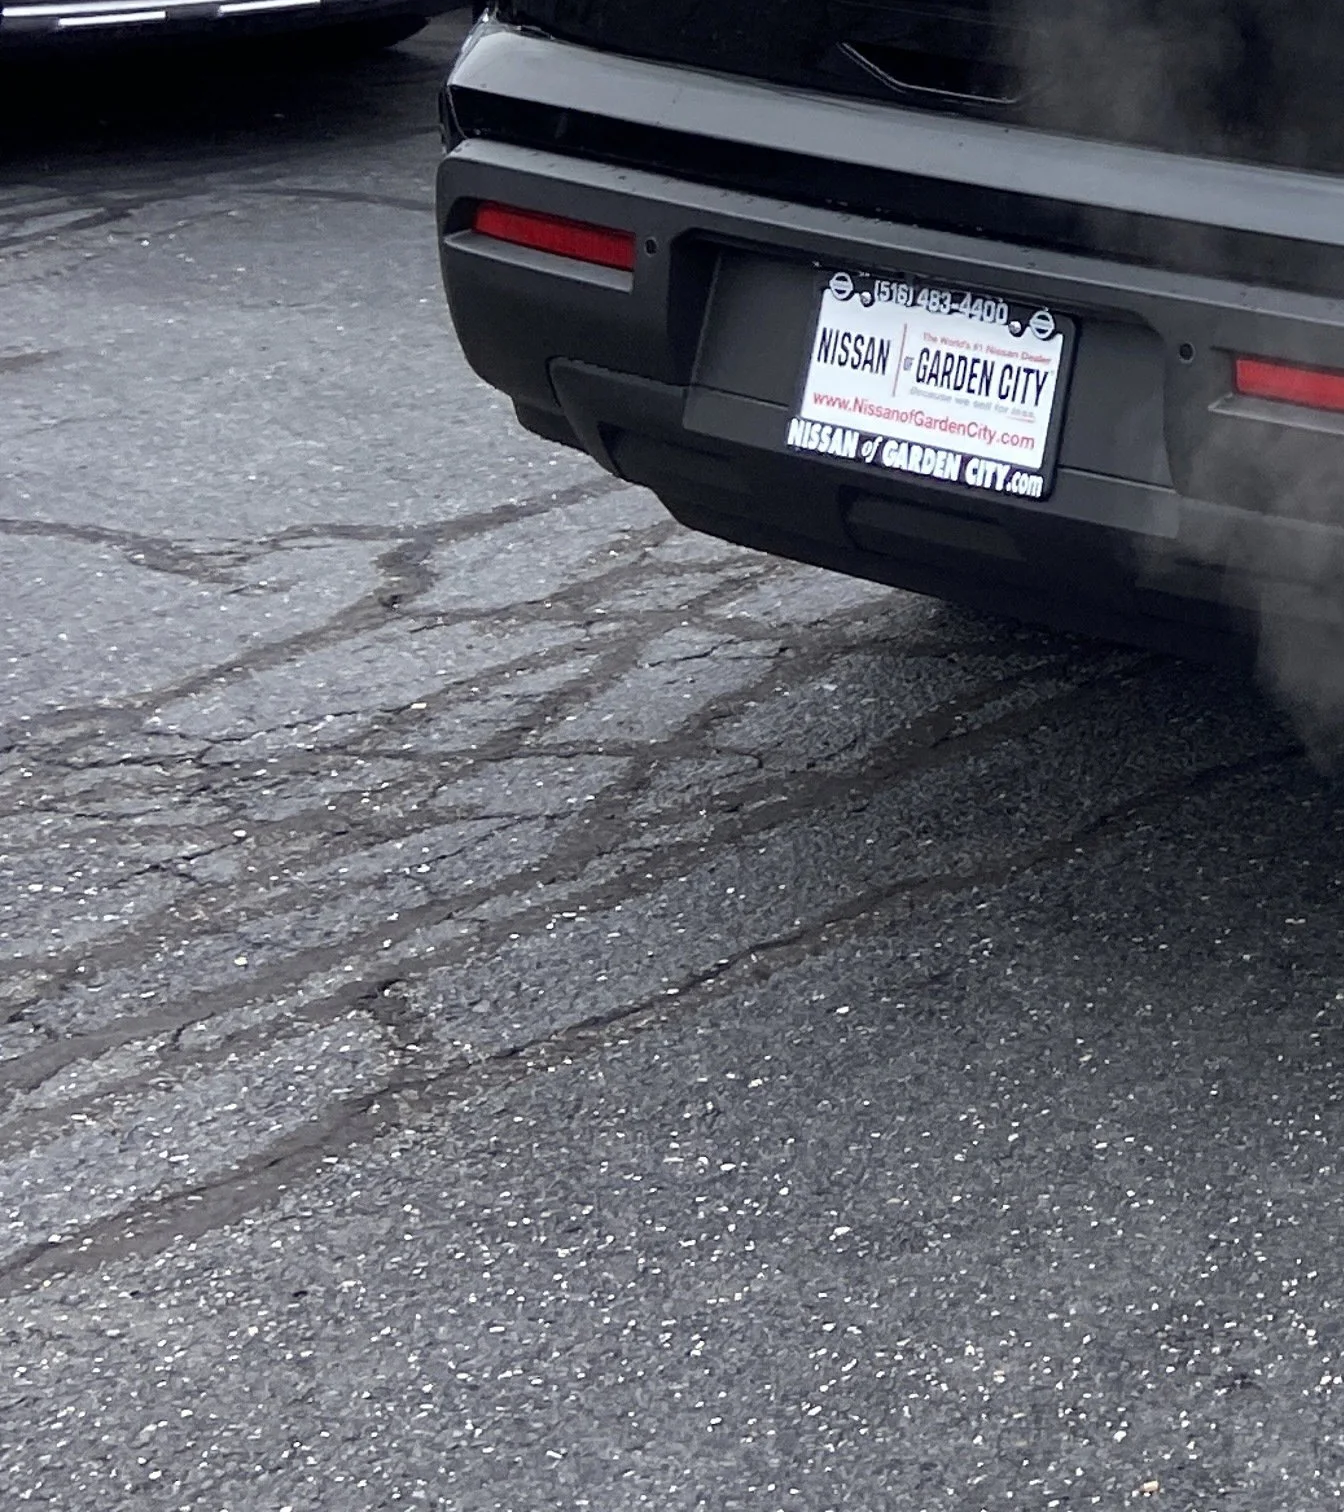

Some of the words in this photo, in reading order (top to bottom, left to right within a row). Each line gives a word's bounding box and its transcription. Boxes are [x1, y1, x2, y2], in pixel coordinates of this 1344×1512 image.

[874, 279, 914, 307] (516)
[917, 288, 1009, 325] 483-4400
[817, 327, 891, 375] NISSAN
[915, 346, 996, 397] GARDEN
[998, 363, 1049, 407] CITY
[813, 391, 1035, 450] www.NissanofGardenCity.com
[787, 417, 859, 460] NISSAN
[861, 435, 883, 463] of
[881, 439, 962, 481] GARDEN
[965, 457, 1043, 498] CITY.com
